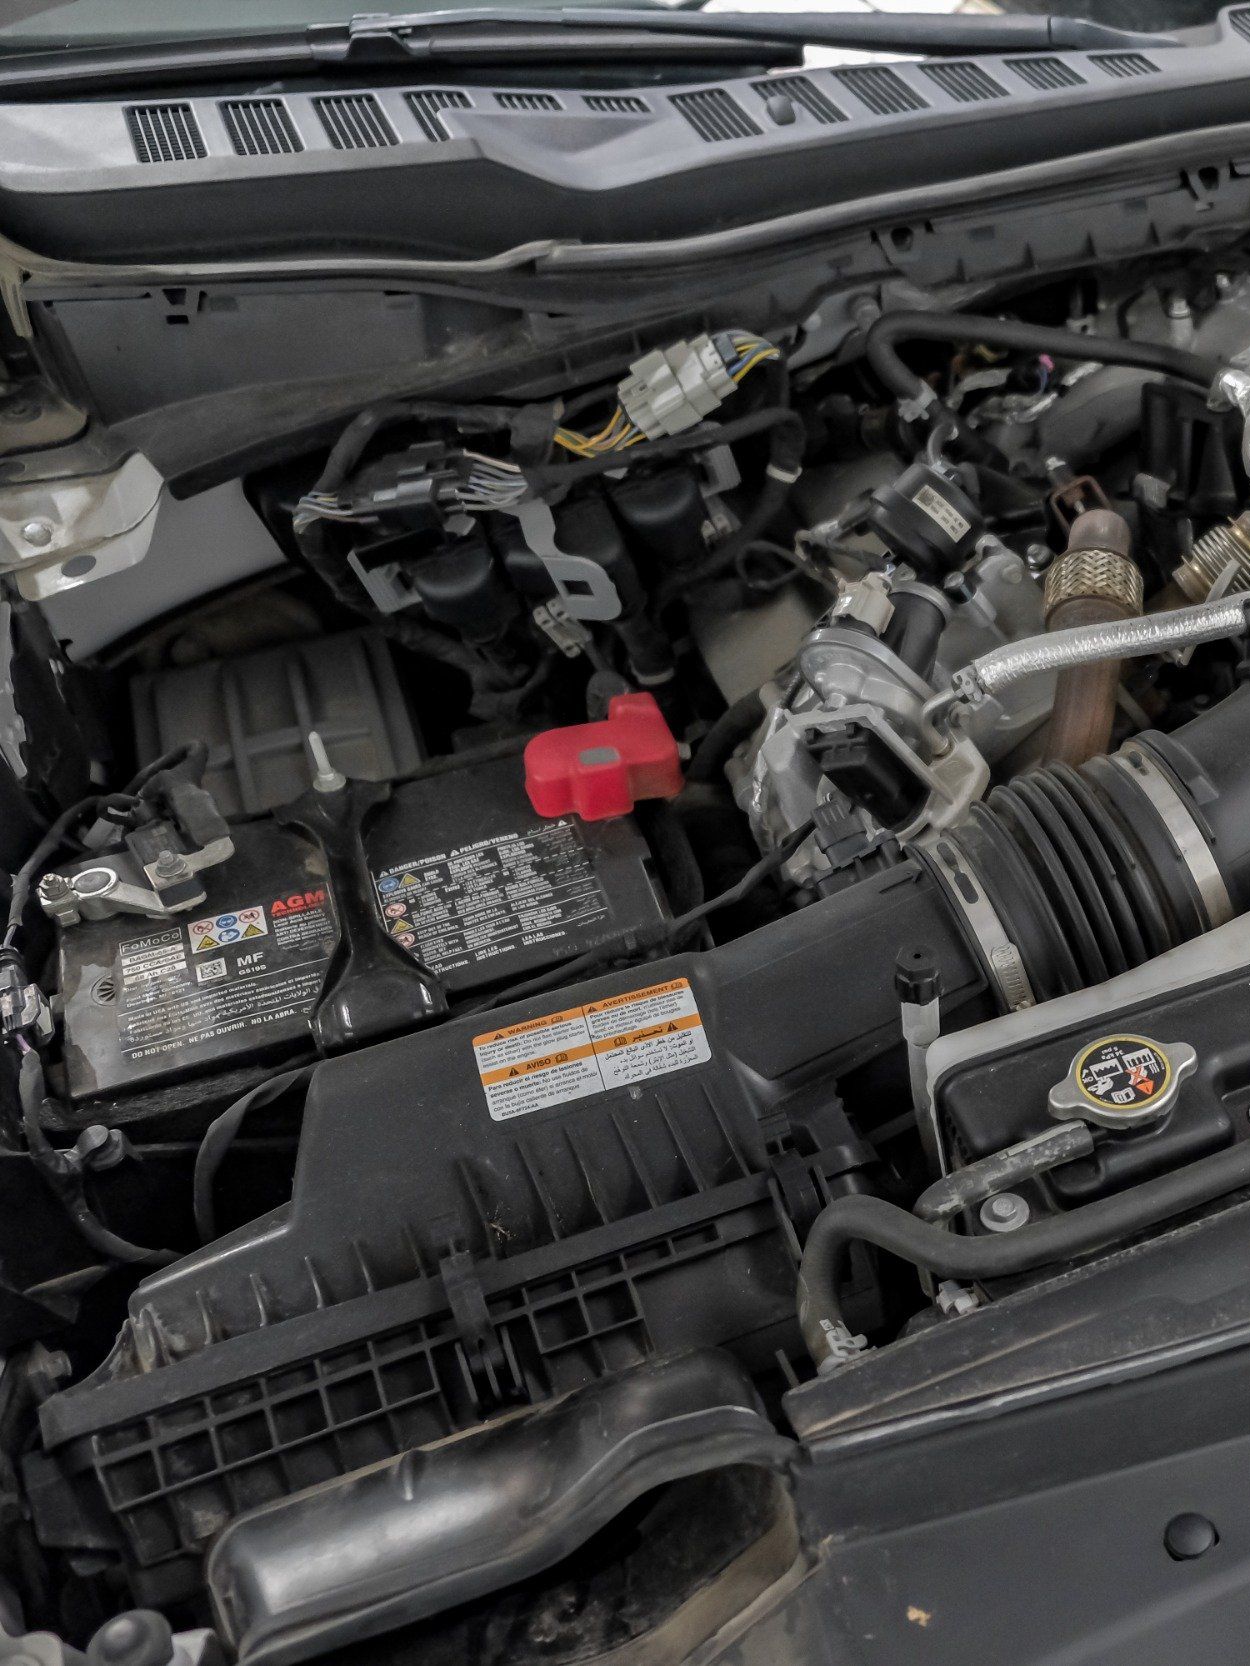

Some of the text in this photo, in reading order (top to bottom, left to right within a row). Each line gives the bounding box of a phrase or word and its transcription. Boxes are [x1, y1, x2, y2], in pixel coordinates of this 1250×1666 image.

[459, 832, 518, 853] PELIGRO/VENENO
[388, 853, 446, 873] DANGER/POISON
[121, 931, 179, 952] FoMoCo
[602, 985, 669, 1008] AVERTISSEMENT
[631, 999, 649, 1008] risque
[657, 989, 684, 1000] blessures
[274, 1007, 296, 1018] ABRA.
[215, 1021, 247, 1034] OUVRIR.
[486, 1040, 506, 1049] reduce
[525, 1027, 550, 1038] possible
[550, 1021, 572, 1030] serious
[507, 1019, 547, 1035] WARNING
[161, 1040, 184, 1051] OPEN.
[542, 1037, 555, 1045] glow
[479, 1048, 496, 1057] injury
[525, 1057, 551, 1070] AVISO
[502, 1077, 523, 1087] reducir
[530, 1070, 549, 1080] riesgo
[558, 1060, 582, 1071] lesiones
[490, 1088, 513, 1098] severas
[519, 1080, 541, 1090] muerte:
[561, 1069, 579, 1077] fluidos
[491, 1094, 517, 1106] arranque
[581, 1071, 598, 1079] motor
